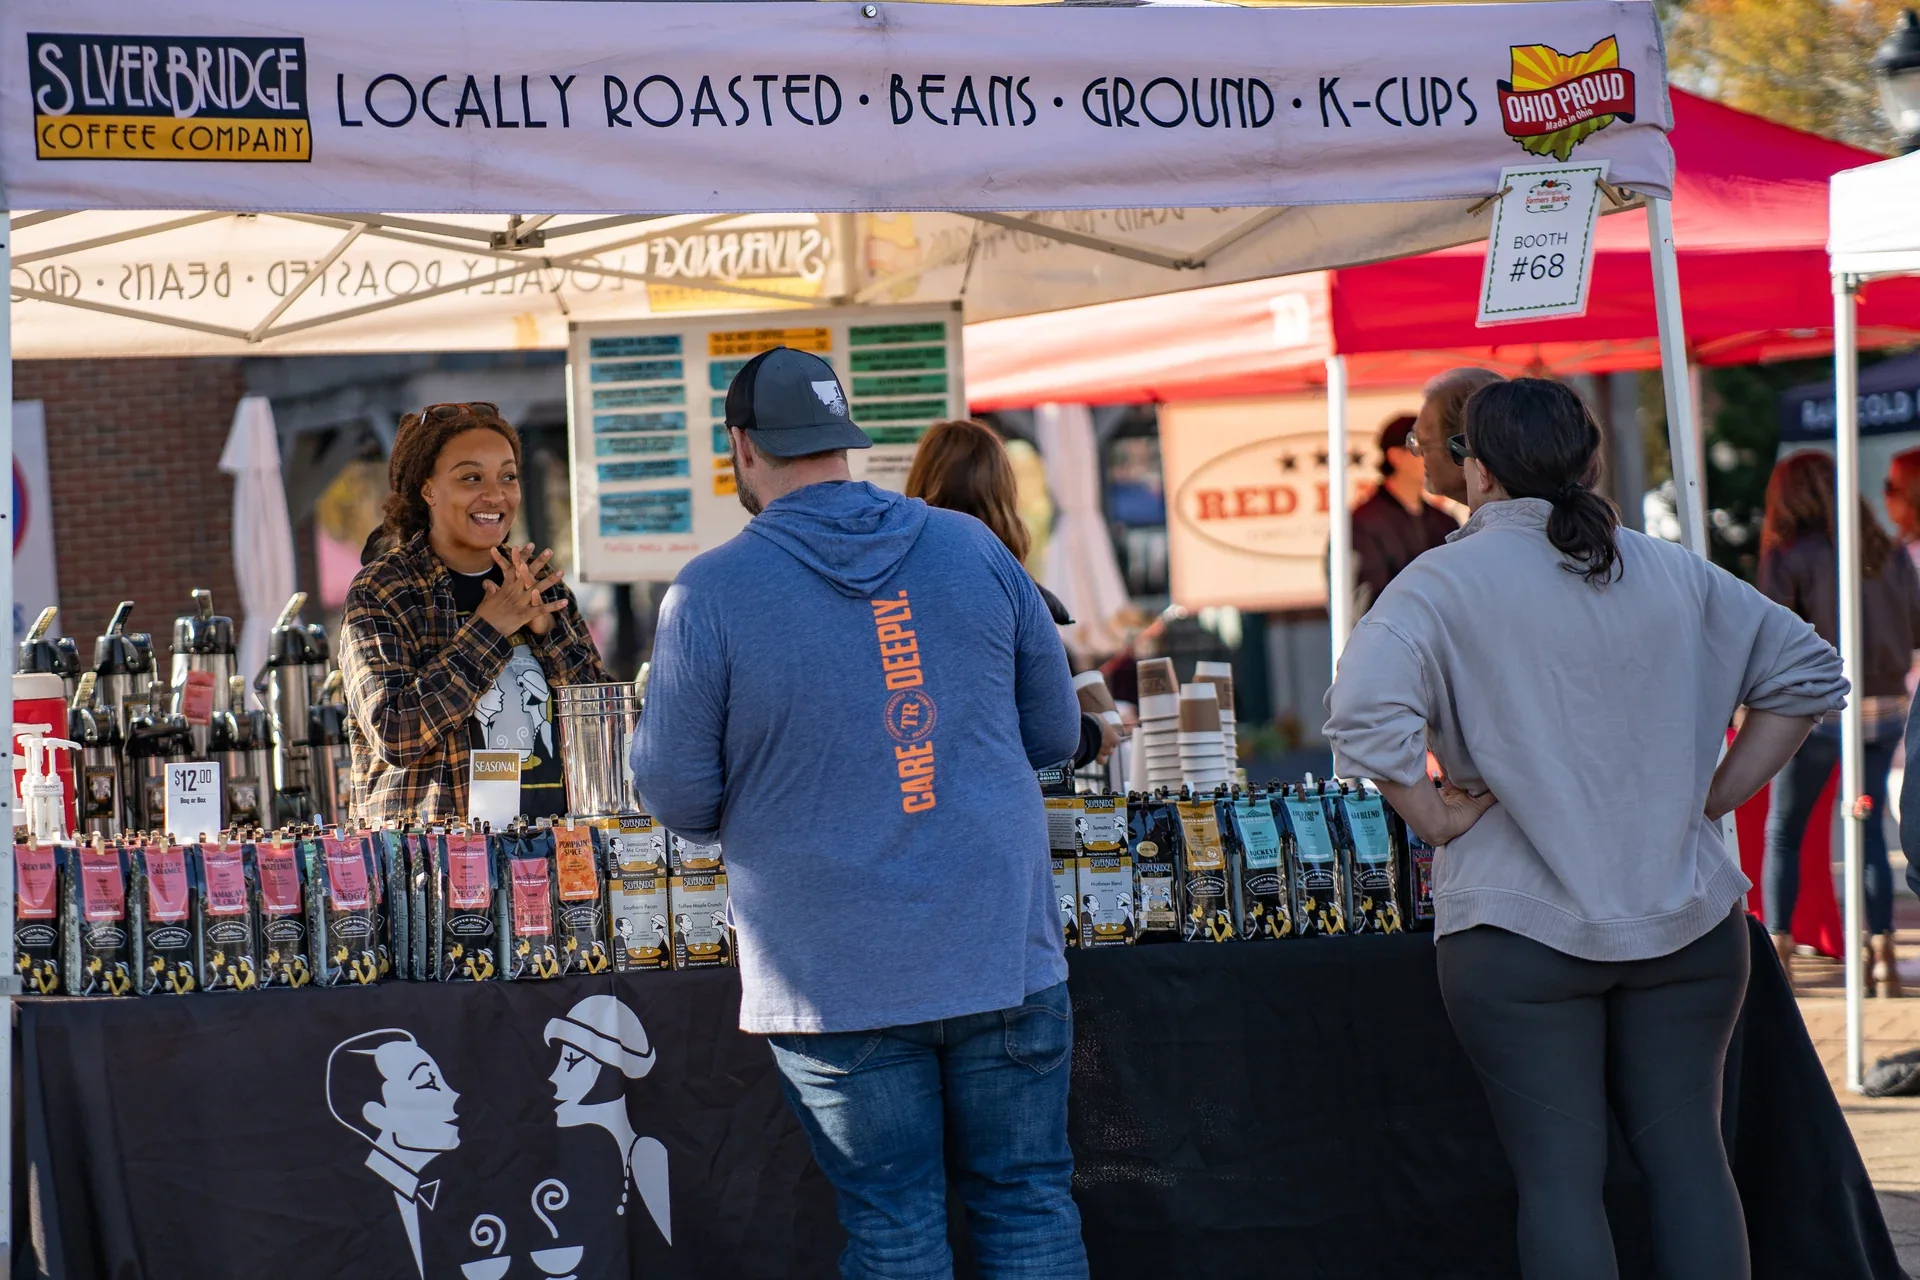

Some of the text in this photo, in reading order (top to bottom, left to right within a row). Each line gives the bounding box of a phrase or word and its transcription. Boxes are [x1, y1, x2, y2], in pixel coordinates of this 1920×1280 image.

[36, 42, 300, 119] SLVERBRIDGE
[336, 73, 1478, 129] LOCALLY ROASTED BEANS GROUND K-CUPS
[1506, 72, 1624, 123] OHIO PROUD
[1545, 108, 1593, 131] Made in Ohio
[42, 123, 304, 152] COFFEE COMPANY
[1525, 195, 1571, 205] Farmers Market
[1513, 232, 1568, 249] BOOTH
[1509, 253, 1565, 282] #68
[1196, 485, 1298, 521] RED
[870, 589, 924, 691] DEEPLY.
[900, 703, 920, 730] TR
[474, 760, 517, 772] SEASONAL
[894, 740, 936, 814] CARE
[174, 769, 212, 791] $12.00
[1360, 811, 1380, 819] BLEND
[560, 840, 588, 849] PUMPKIN
[212, 888, 242, 898] JAMAICAN
[336, 892, 366, 902] GROGG
[454, 890, 485, 898] PECAN
